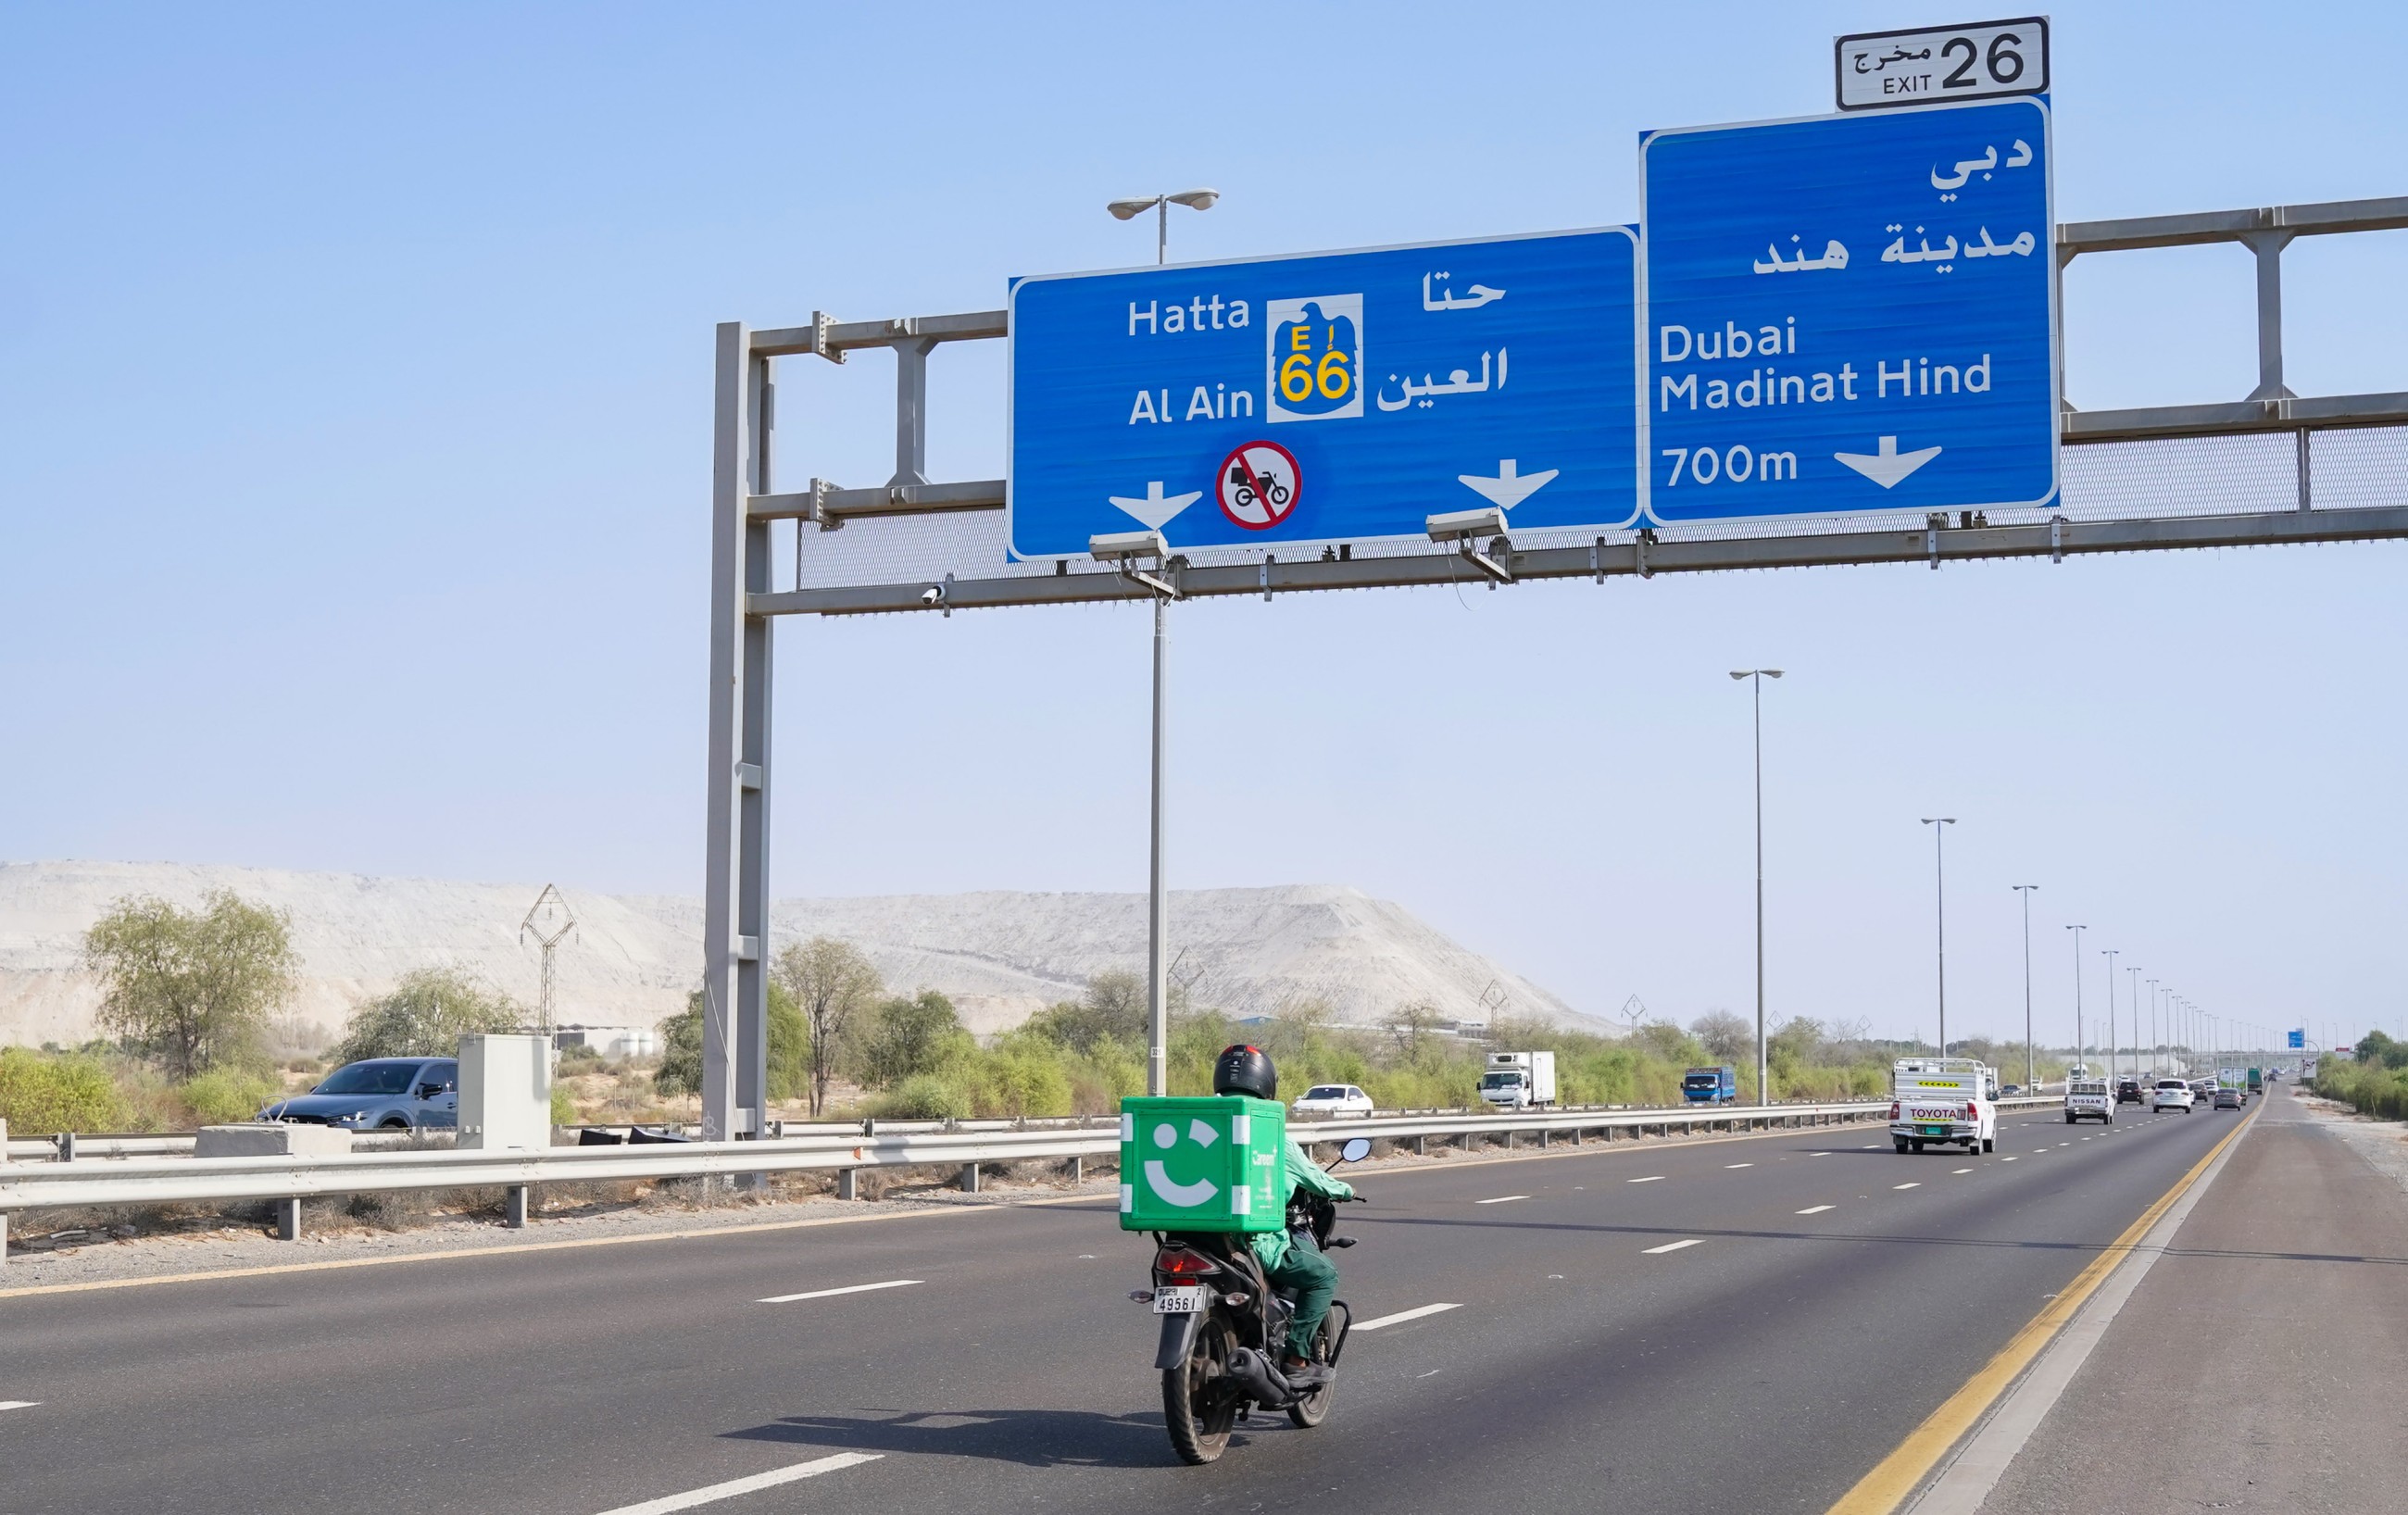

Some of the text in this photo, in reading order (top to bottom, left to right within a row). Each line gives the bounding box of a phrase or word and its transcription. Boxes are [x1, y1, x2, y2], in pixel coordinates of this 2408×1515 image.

[1853, 44, 1932, 74] مخرج
[1940, 32, 2025, 90] 26
[1883, 74, 1932, 94] EXIT
[1931, 138, 2033, 204] دبي
[1753, 223, 2036, 275] مدينة هند
[1422, 271, 1507, 312] حتا
[1128, 294, 1250, 336] Hatta
[1291, 325, 1311, 352] E
[1661, 316, 1796, 363] Dubai
[1280, 350, 1350, 403] 66
[1377, 347, 1508, 412] العين
[1661, 353, 1992, 412] Madinat Hind
[1128, 382, 1255, 425] Al Ain
[1662, 444, 1798, 487] 700m
[1910, 1108, 1957, 1119] TOYOTA
[1160, 1297, 1196, 1311] 49561
